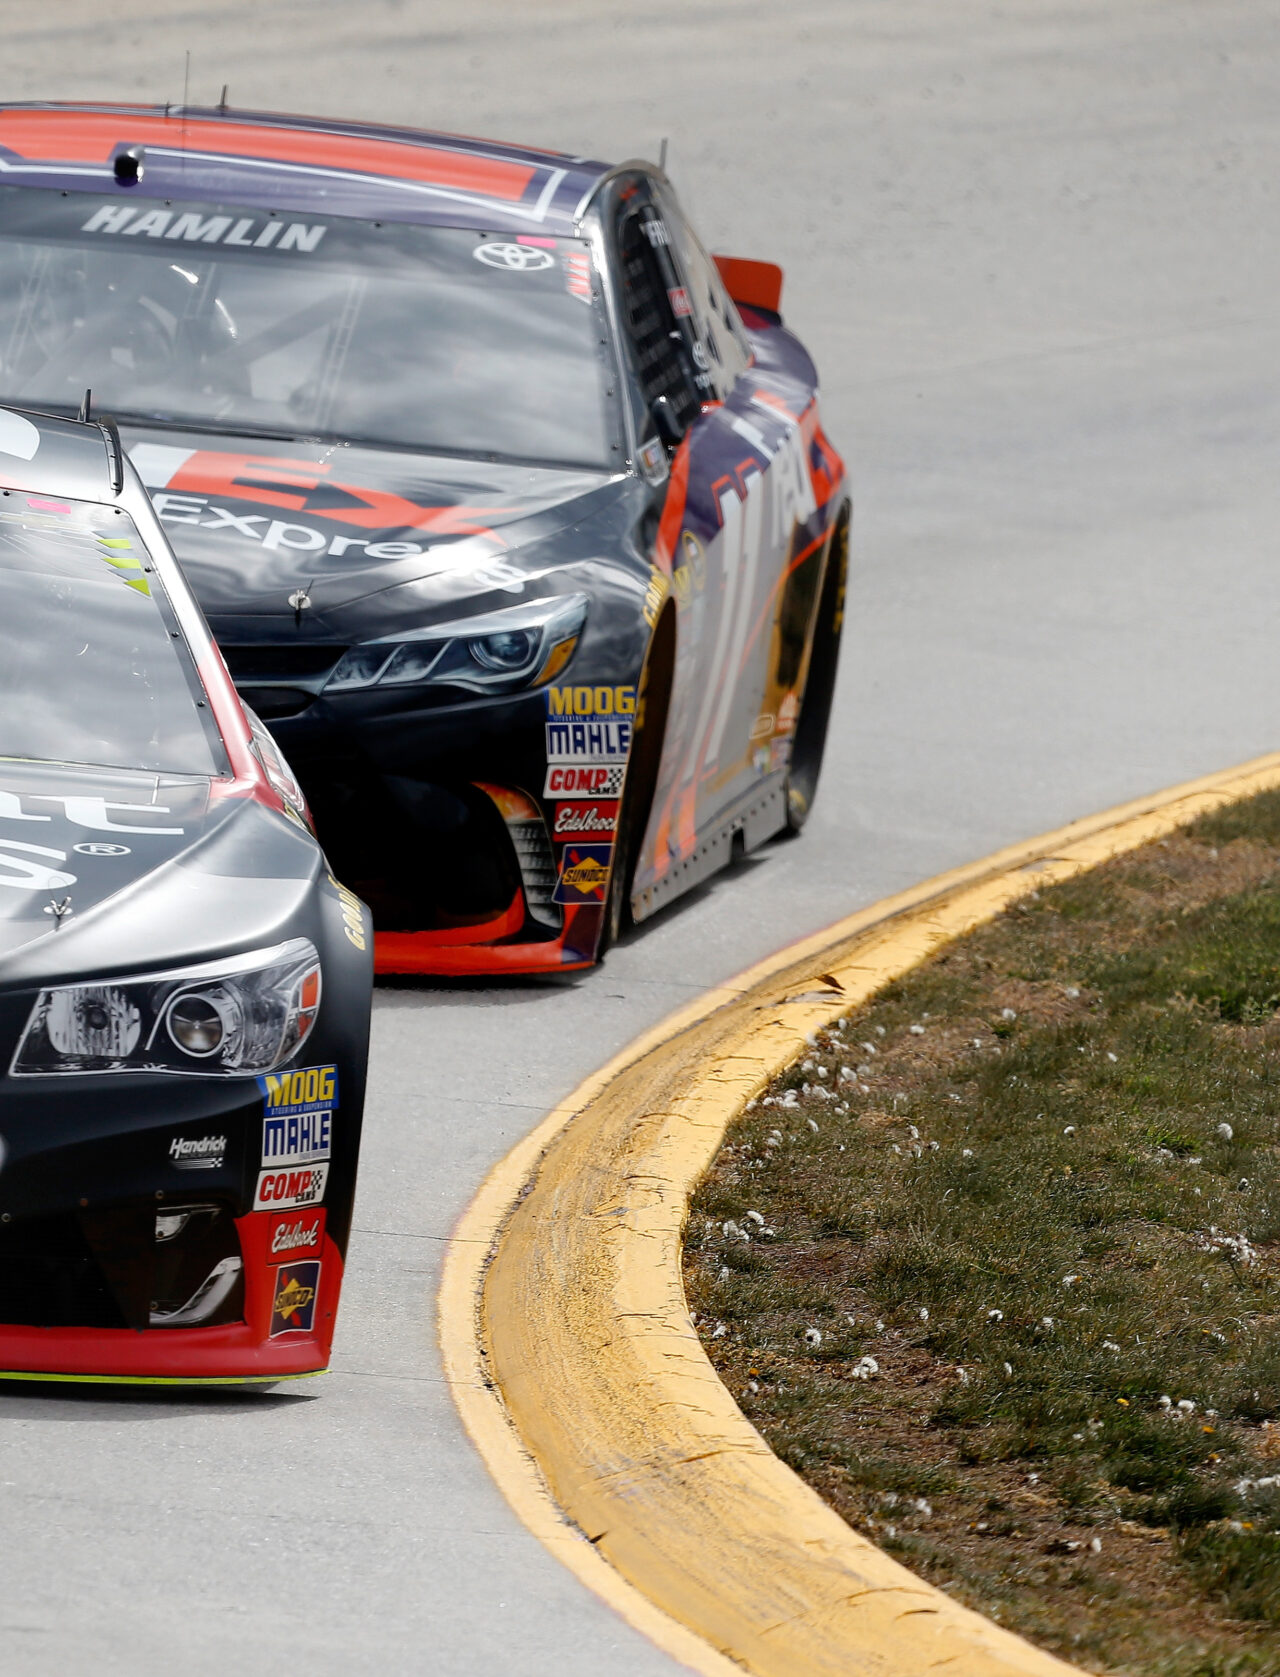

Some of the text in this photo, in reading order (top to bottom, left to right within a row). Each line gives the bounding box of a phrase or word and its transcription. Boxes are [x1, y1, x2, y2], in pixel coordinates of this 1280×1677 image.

[81, 205, 328, 253] HAMLIN
[150, 494, 526, 594] Expres
[548, 686, 635, 715] MOOG
[548, 724, 631, 755] MAHLE
[549, 768, 608, 791] COMP
[588, 787, 618, 795] CAMS
[554, 807, 618, 832] Edelbroc
[264, 1067, 336, 1108] MOOG
[169, 1135, 227, 1159] Hendrick
[263, 1112, 330, 1157] MAHLE
[259, 1170, 312, 1202] COMP
[295, 1190, 316, 1203] CAMS
[272, 1219, 319, 1253] Edelbrock
